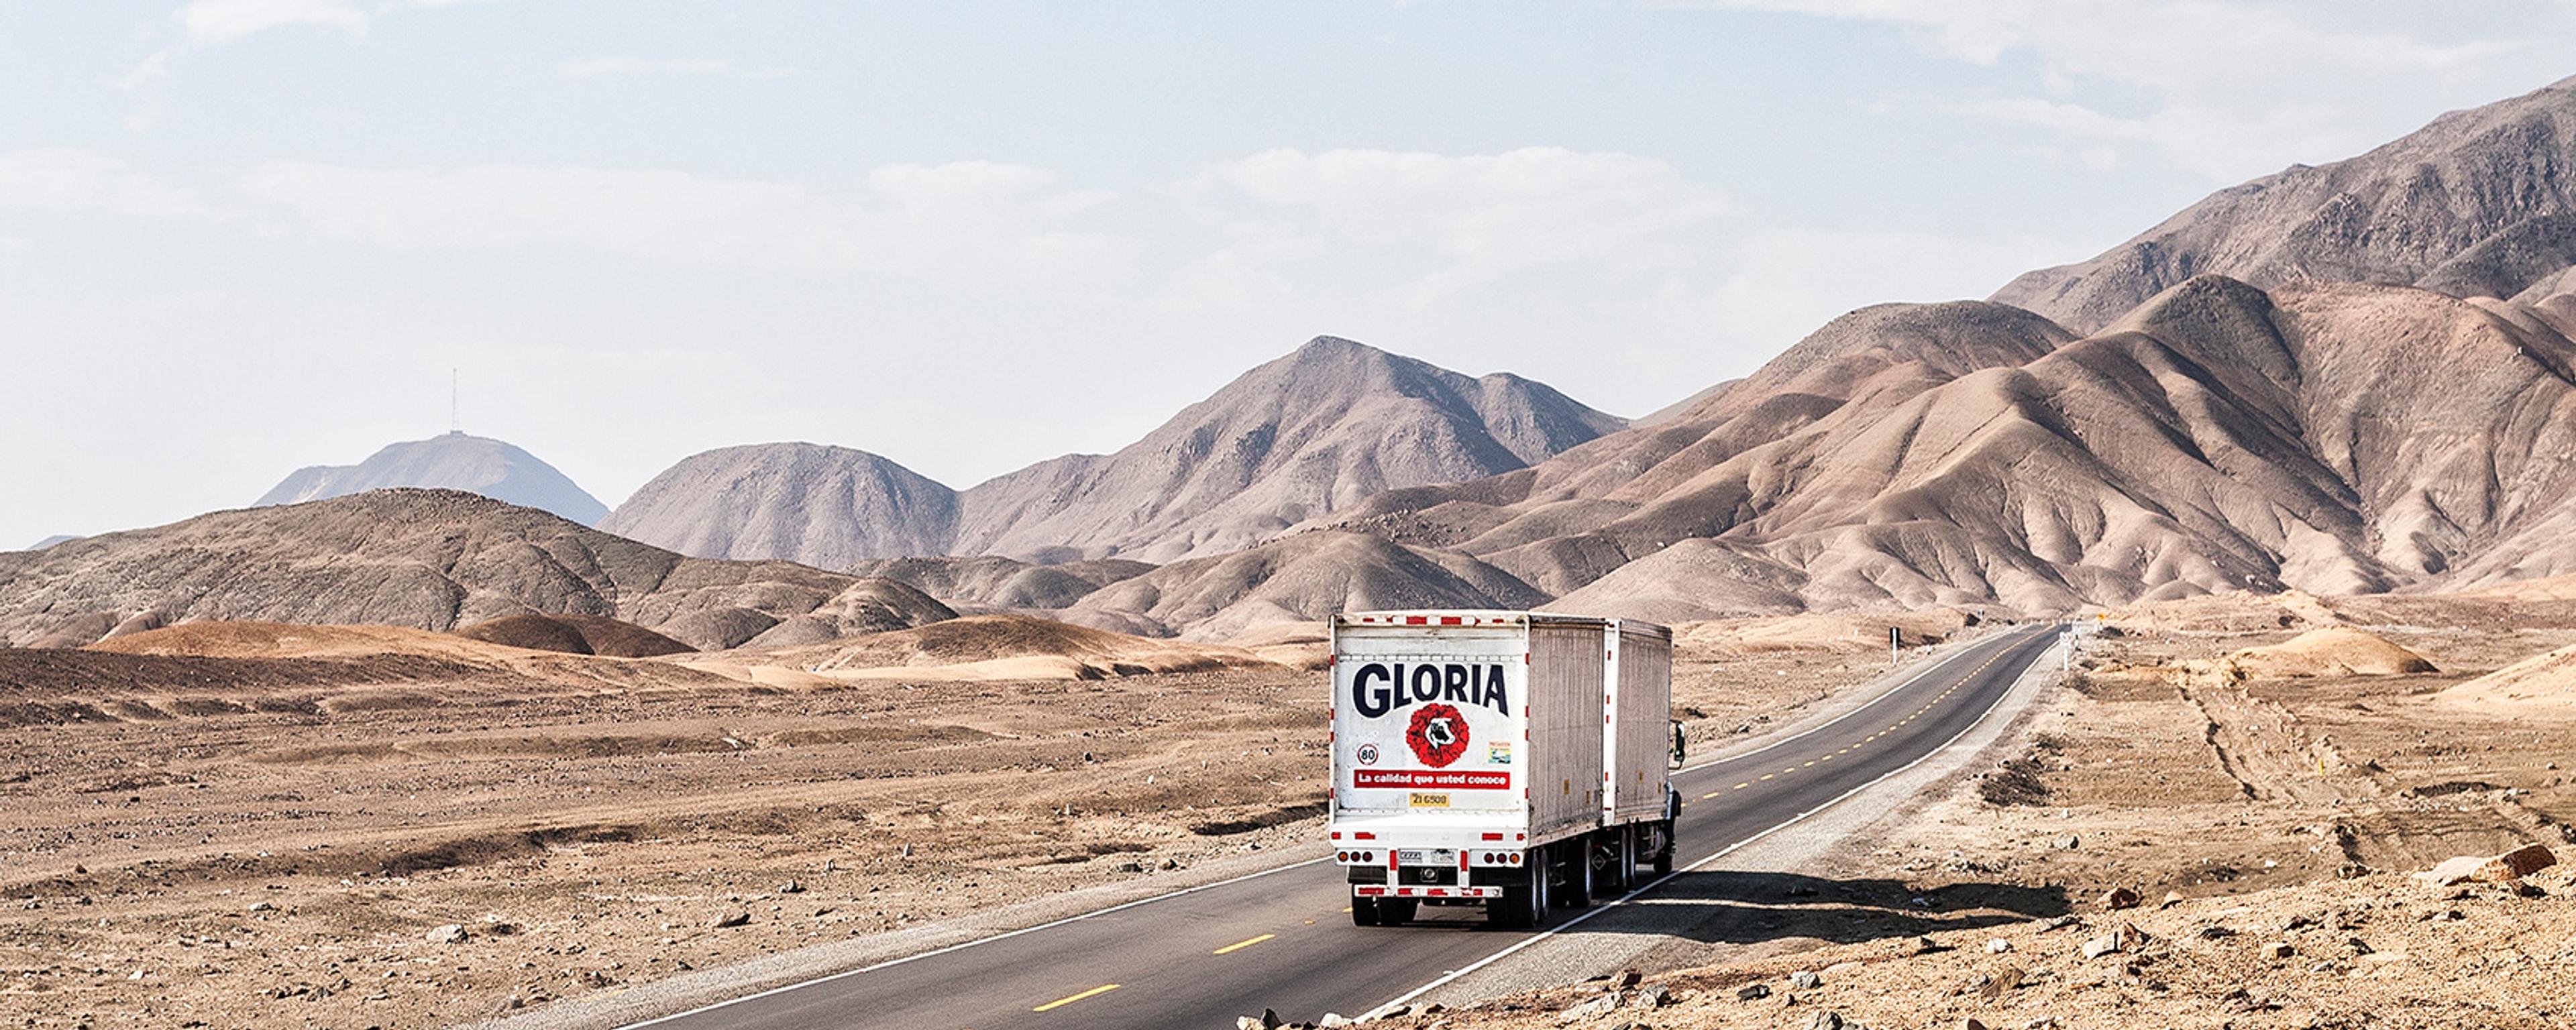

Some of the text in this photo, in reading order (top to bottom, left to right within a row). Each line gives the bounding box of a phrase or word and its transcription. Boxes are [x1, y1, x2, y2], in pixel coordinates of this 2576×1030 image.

[1353, 663, 1509, 718] GLORIA
[1361, 749, 1375, 760] 80
[1358, 773, 1506, 785] La calidad que usted conoce
